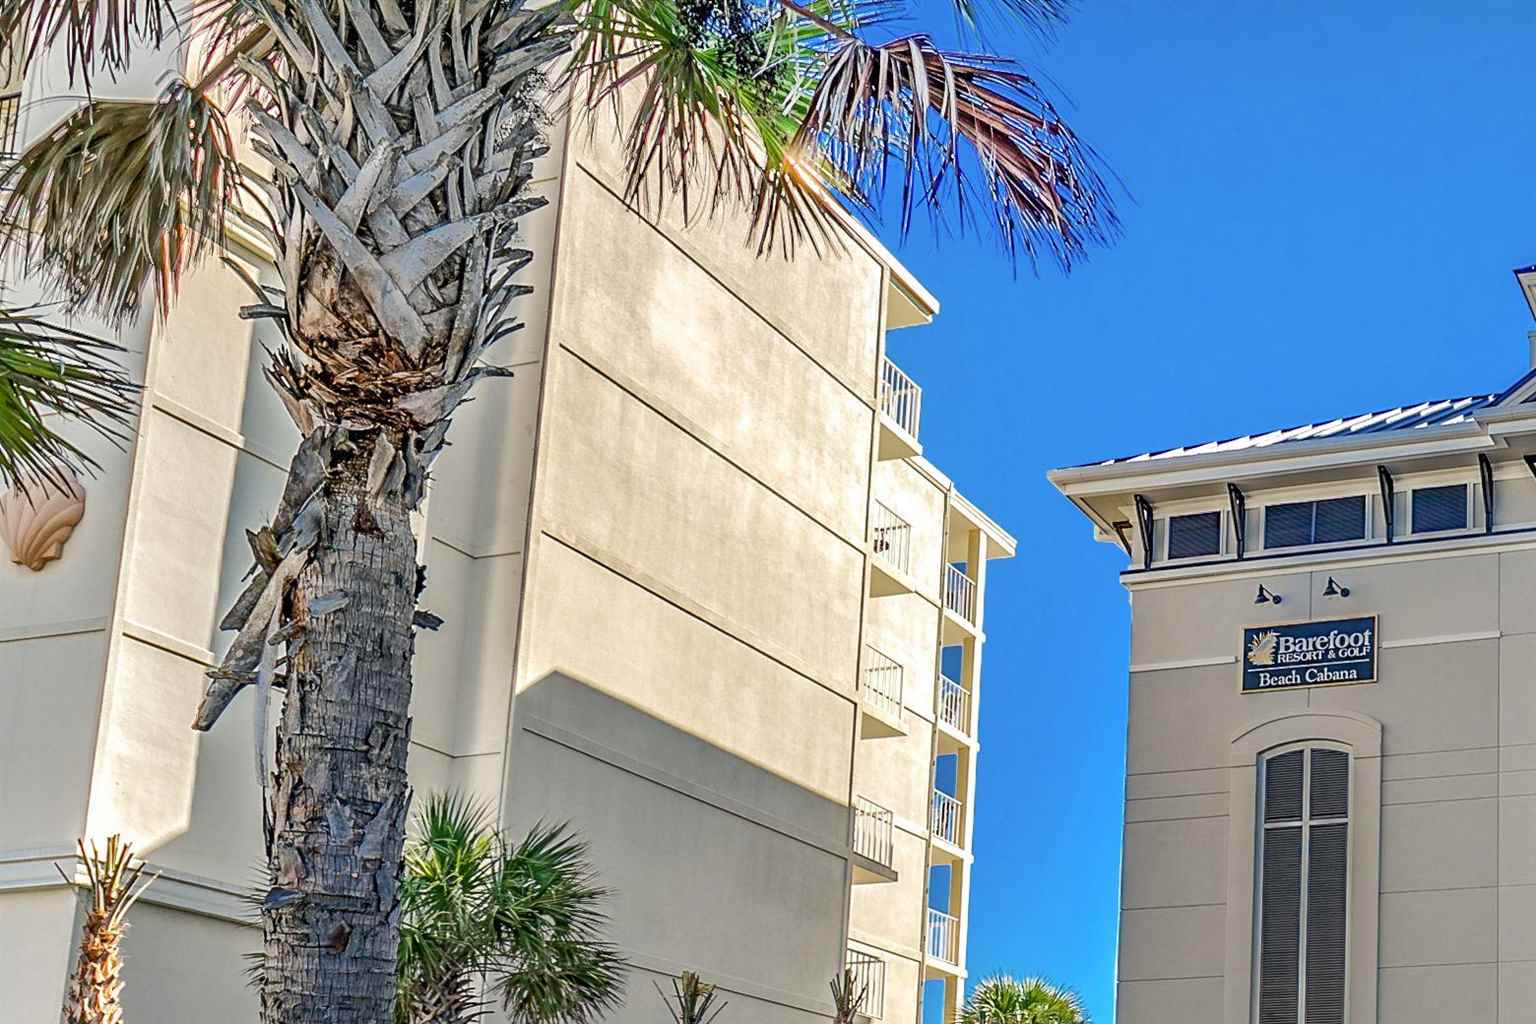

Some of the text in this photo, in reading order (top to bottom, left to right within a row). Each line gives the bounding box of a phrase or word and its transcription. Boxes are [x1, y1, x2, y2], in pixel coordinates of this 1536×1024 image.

[1279, 629, 1371, 653] Barefoot
[1277, 646, 1370, 663] RESORT & GOLF
[1259, 667, 1357, 687] Beach Cabana
